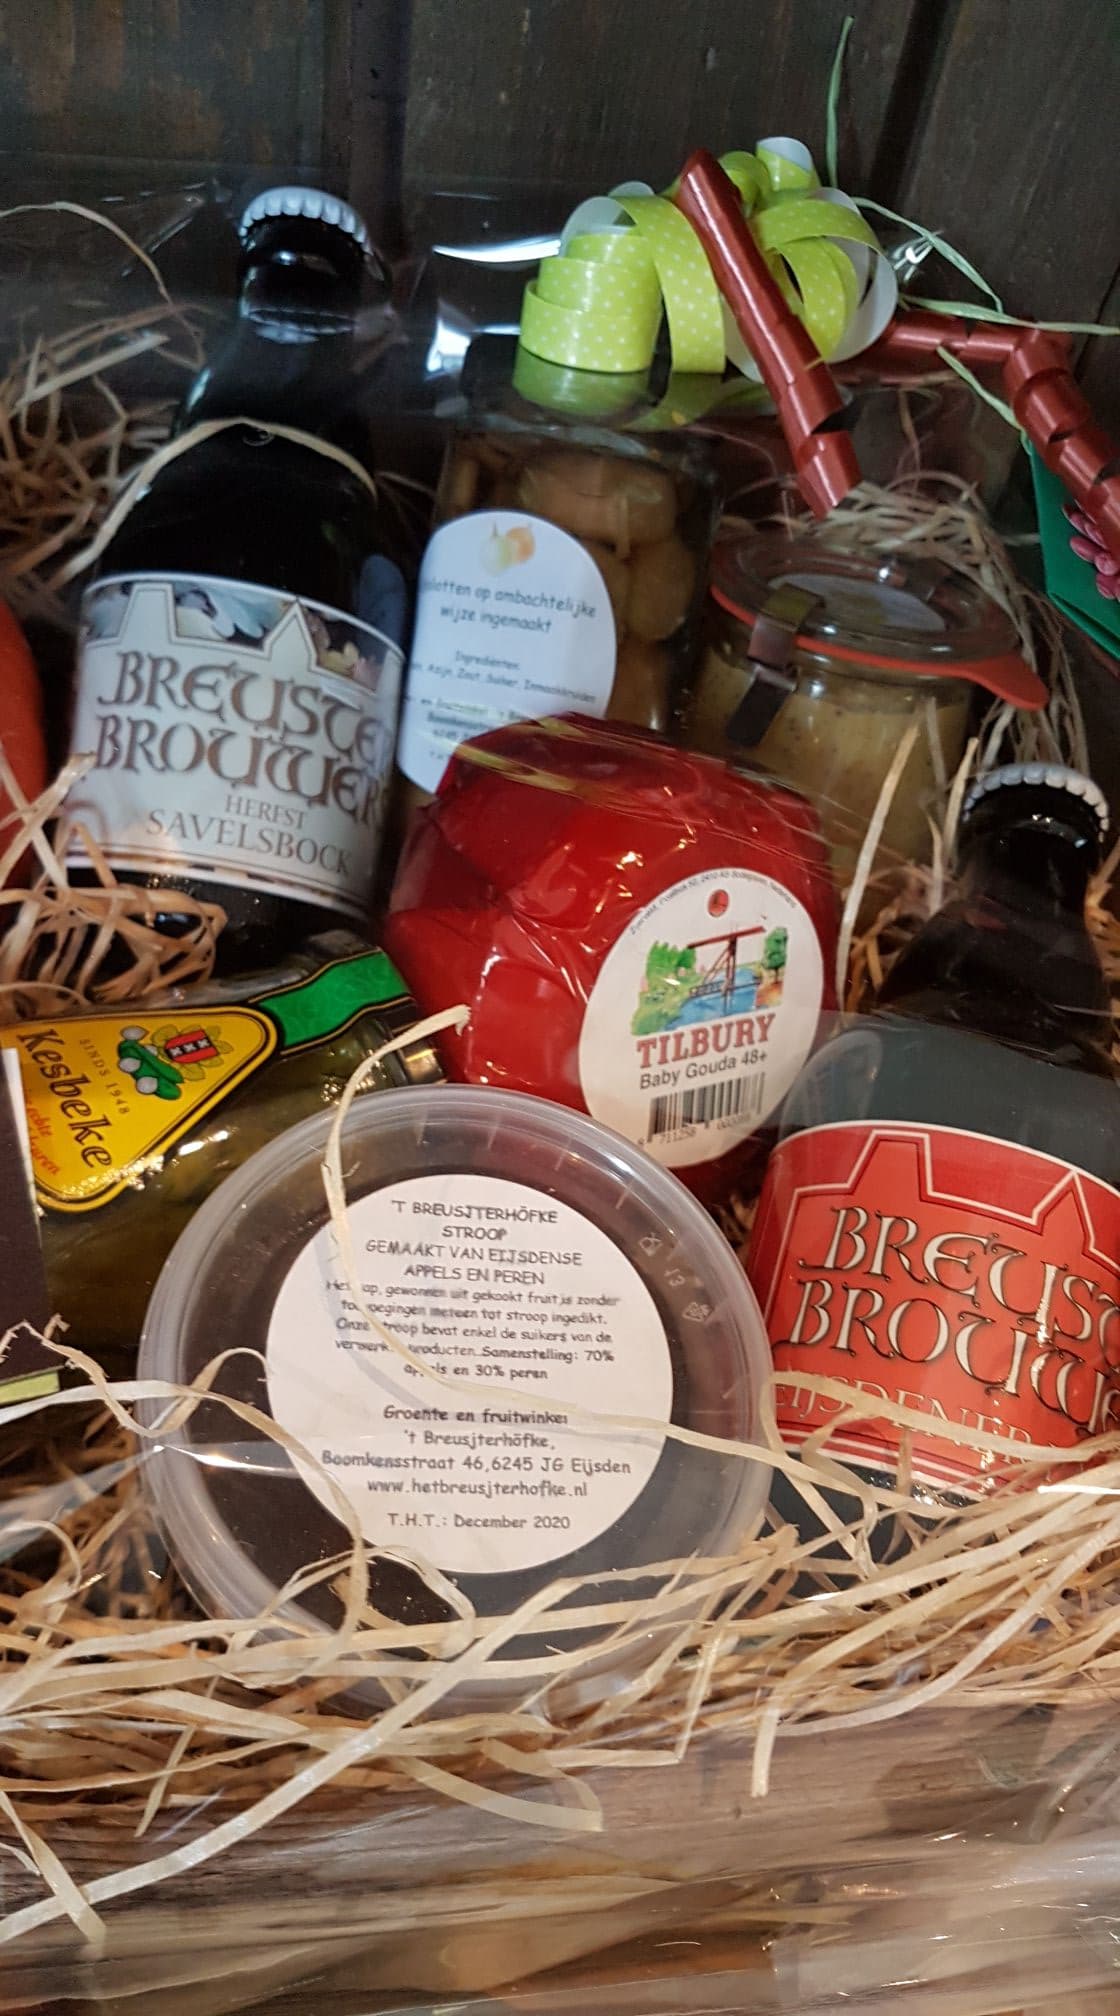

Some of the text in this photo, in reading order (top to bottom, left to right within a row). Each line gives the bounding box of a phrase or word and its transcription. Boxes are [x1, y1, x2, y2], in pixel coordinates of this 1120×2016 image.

[475, 586, 491, 601] op
[495, 588, 597, 619] ambachtelijke
[441, 606, 552, 633] wijze ingemaakt
[224, 793, 305, 830] HERFST
[146, 807, 354, 877] SAVELSBOCK
[636, 1012, 776, 1069] TILBURY
[79, 1038, 130, 1115] SINDS 1948
[640, 1050, 768, 1091] Baby Gouda 48+
[17, 1028, 113, 1168] Kesbeke
[441, 1225, 507, 1241] STROOP
[366, 1239, 583, 1266] GEMAAKT VAN EIJSDENSE
[404, 1264, 545, 1285] APPELS EN PEREN
[472, 1290, 522, 1304] gekookt
[528, 1291, 557, 1305] fruit
[336, 1316, 371, 1331] Onze
[422, 1321, 457, 1337] bevat
[462, 1325, 496, 1339] enkel
[500, 1327, 516, 1340] de
[520, 1328, 567, 1343] suikers
[570, 1333, 593, 1343] van
[596, 1331, 613, 1344] de
[481, 1308, 501, 1320] tot
[506, 1310, 548, 1325] stroop
[551, 1311, 607, 1327] ingedikt.
[482, 1345, 578, 1365] Samenstelling:
[584, 1349, 615, 1362] 70%
[453, 1365, 469, 1376] en
[475, 1364, 505, 1378] 30%
[509, 1367, 548, 1381] peren
[383, 1404, 448, 1421] Groente
[456, 1410, 475, 1422] en
[404, 1429, 416, 1444] 't
[321, 1450, 632, 1477] Boomkensstraat 46,6245 JG Eijsden
[367, 1477, 588, 1499] www.hetbreusjterhofke.nl
[387, 1511, 571, 1530] T.H.T.: December 2020
